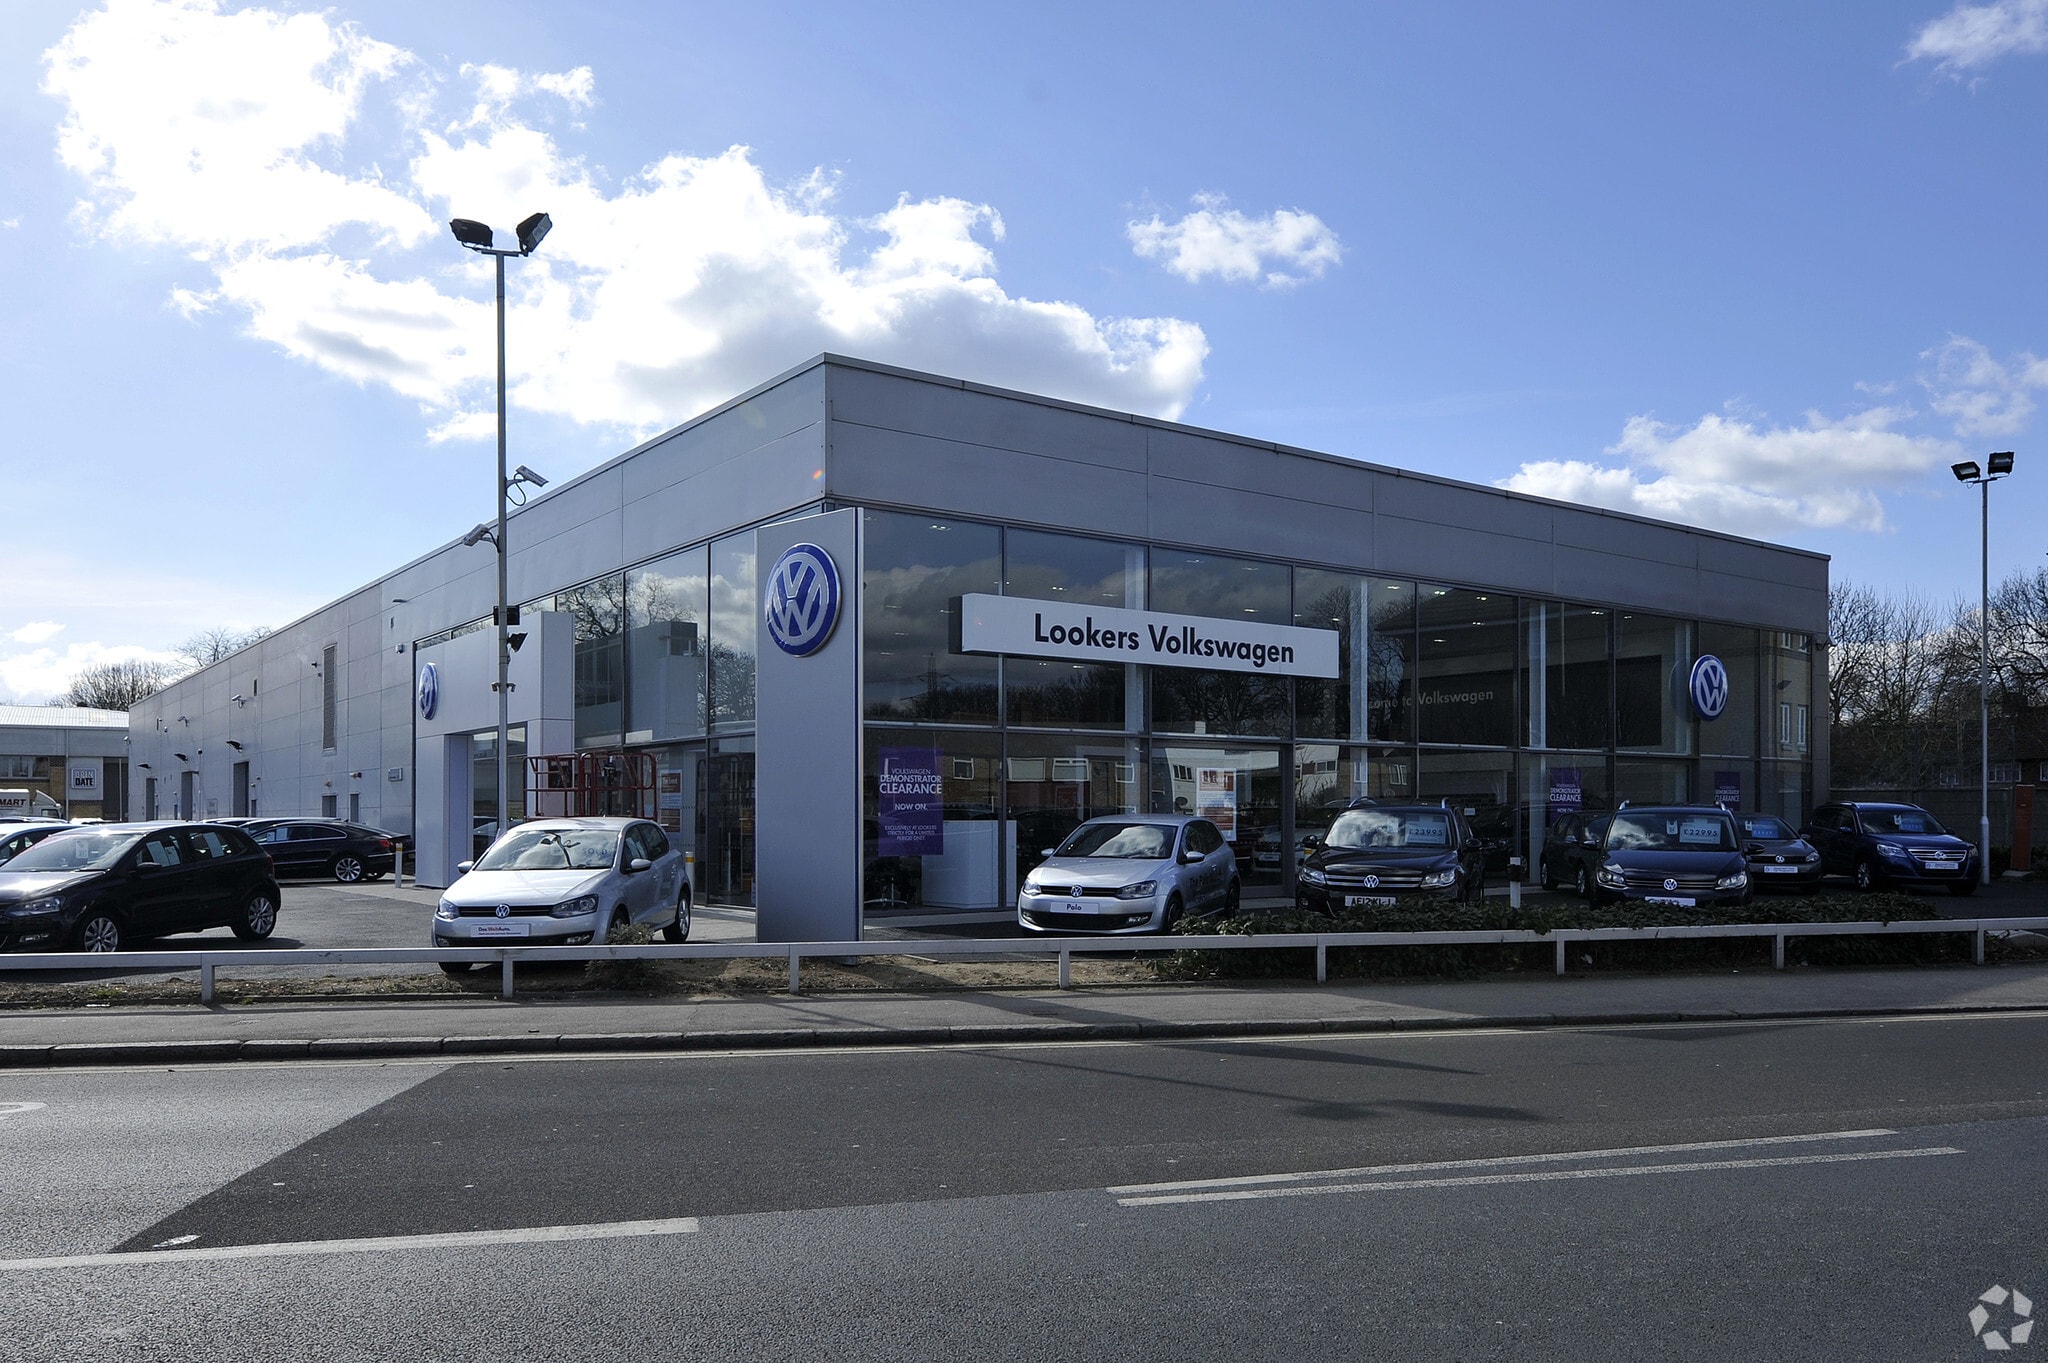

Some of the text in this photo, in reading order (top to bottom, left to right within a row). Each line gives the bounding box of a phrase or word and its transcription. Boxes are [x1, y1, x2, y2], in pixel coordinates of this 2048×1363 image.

[1035, 612, 1294, 668] Lookers Volkswagen
[1418, 690, 1494, 705] Volkswagen
[75, 778, 94, 786] DATE
[880, 774, 942, 783] DEMONSTRATOR
[879, 783, 942, 794] CLEARANCE
[1549, 793, 1581, 802] CLEARANCE
[894, 803, 914, 811] NOW
[1683, 829, 1718, 837] £22995
[582, 847, 608, 855] SOLD
[1066, 903, 1082, 911] Polo
